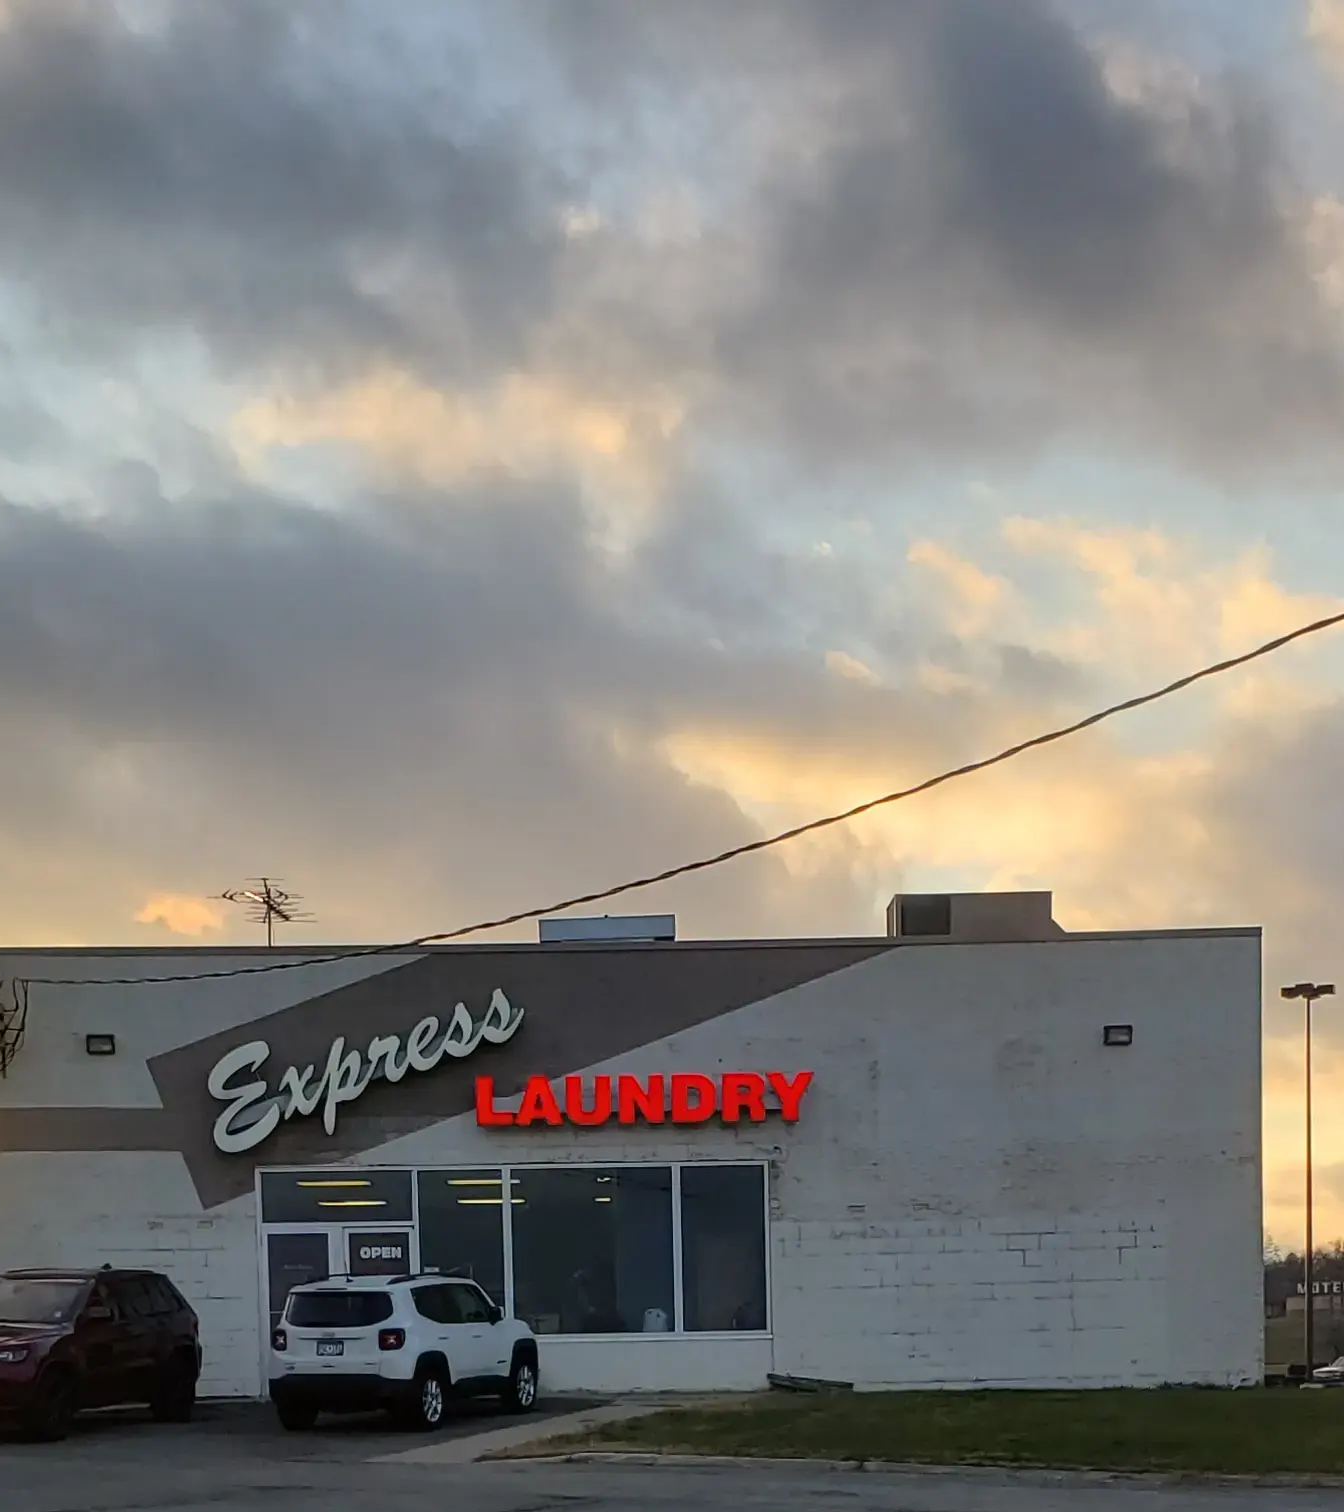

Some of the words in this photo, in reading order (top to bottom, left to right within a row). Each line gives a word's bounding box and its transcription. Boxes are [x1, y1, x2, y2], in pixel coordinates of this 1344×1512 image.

[207, 988, 525, 1154] Express
[474, 1071, 814, 1127] LAUNDRY
[359, 1246, 402, 1259] OPEN
